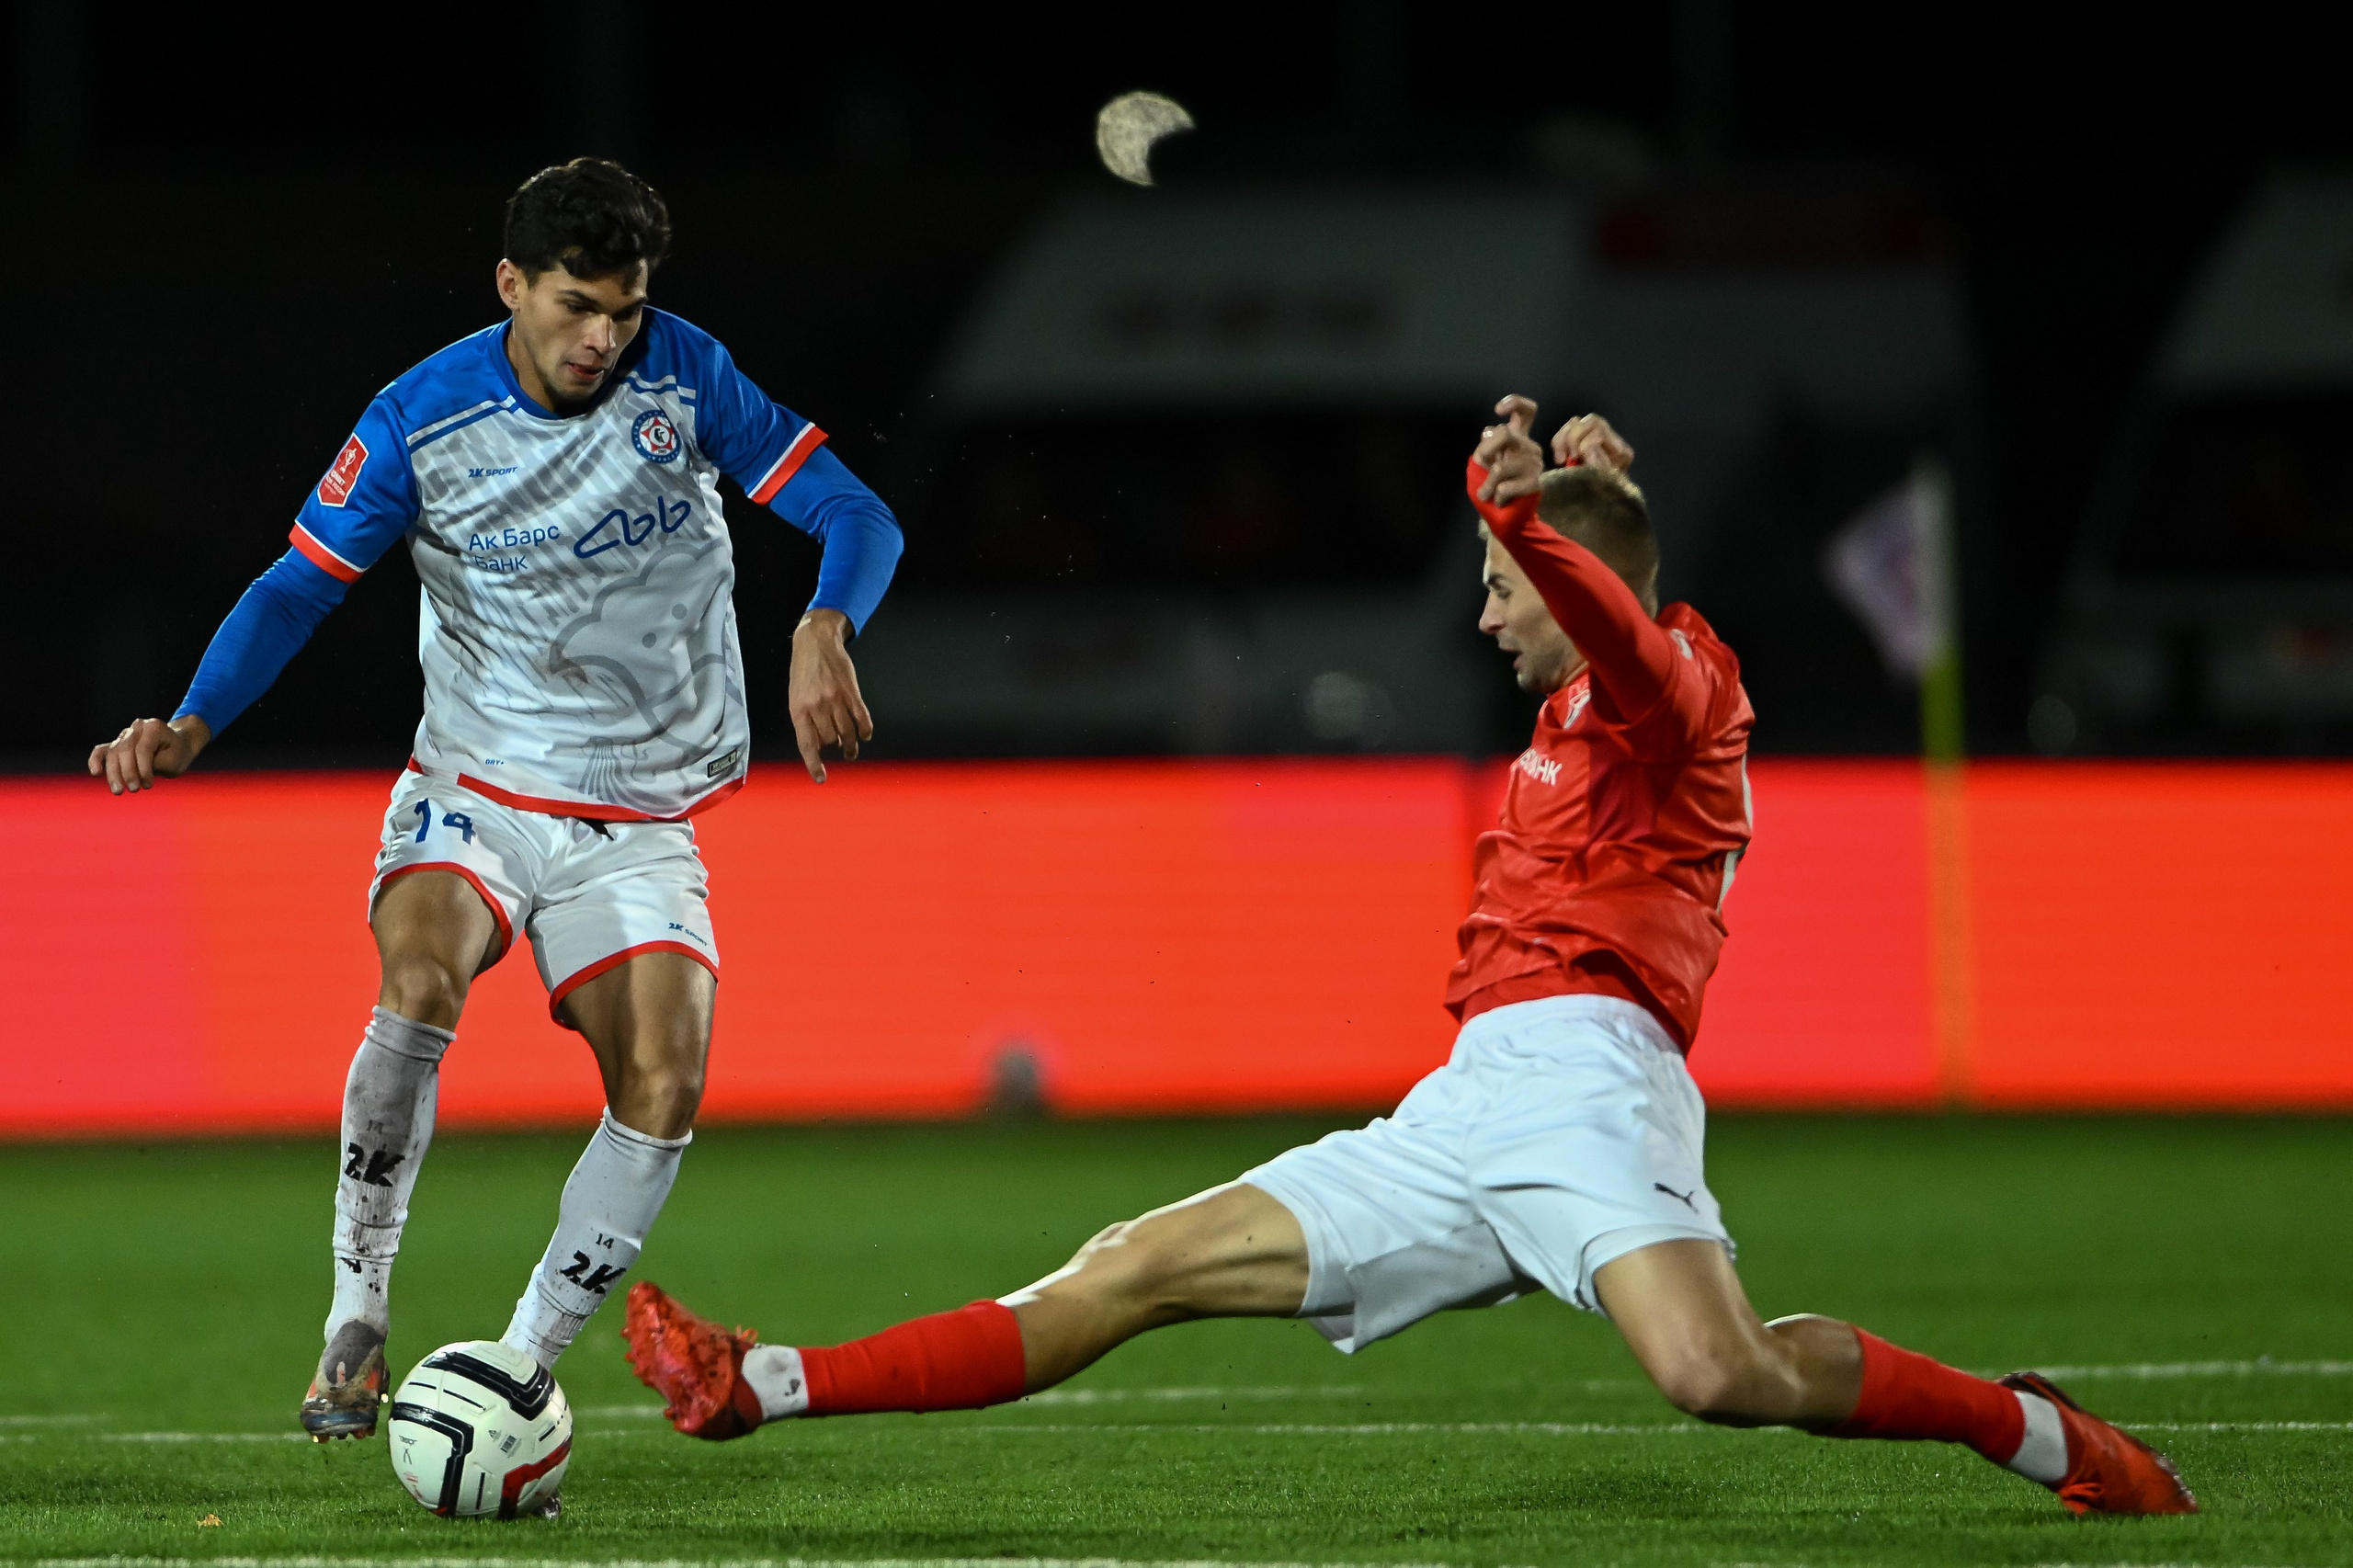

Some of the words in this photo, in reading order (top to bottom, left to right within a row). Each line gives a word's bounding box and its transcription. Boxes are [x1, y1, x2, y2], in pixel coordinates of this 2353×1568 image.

[468, 468, 484, 478] 2K
[485, 466, 518, 477] SPORT
[469, 533, 499, 551] Ак
[503, 525, 560, 548] Барс
[474, 554, 529, 572] Банк
[413, 798, 477, 846] 14
[668, 922, 685, 932] 2K
[685, 928, 708, 947] SPORT
[344, 1142, 406, 1188] 2K
[595, 1233, 615, 1250] 14
[560, 1249, 627, 1295] 2K
